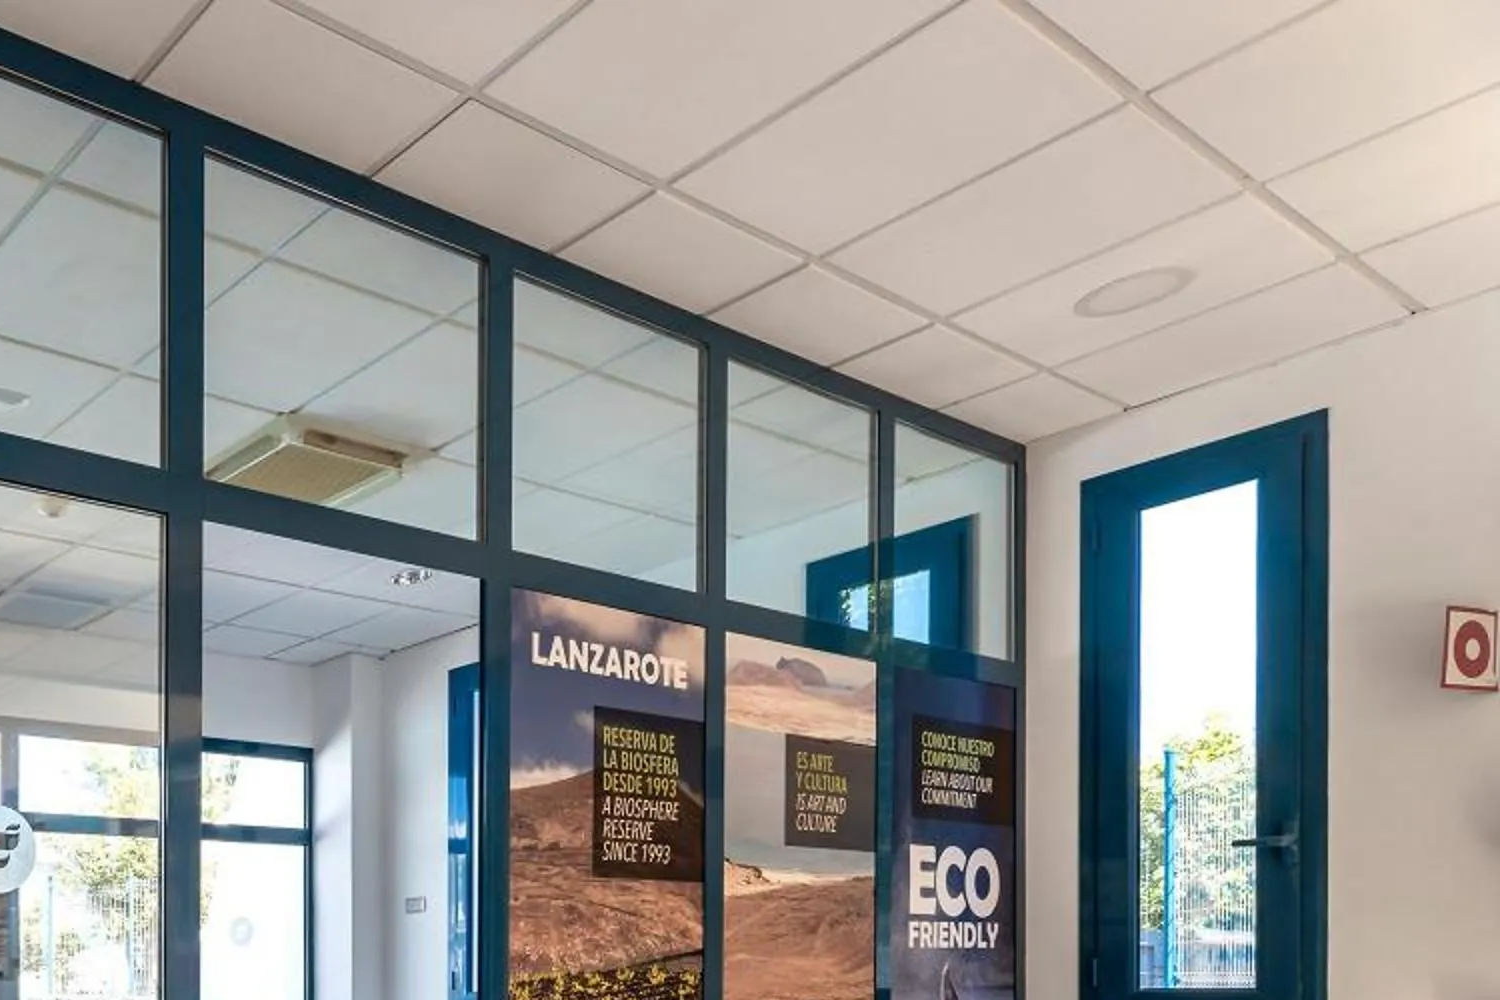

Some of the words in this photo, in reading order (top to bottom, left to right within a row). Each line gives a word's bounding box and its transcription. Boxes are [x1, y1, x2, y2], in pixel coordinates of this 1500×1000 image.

[531, 631, 689, 691] LANZAROTE
[603, 725, 657, 751] RESERVA
[659, 733, 677, 755] DE
[603, 748, 617, 769] LA
[621, 751, 680, 777] BIOSFERA
[796, 751, 808, 769] ES
[809, 753, 834, 773] ARTE
[603, 771, 643, 795] DESDE
[646, 777, 677, 798] 1993
[796, 770, 803, 789] Y
[804, 771, 848, 795] CULTURA
[602, 795, 612, 815] A
[613, 798, 681, 821] BIOSPHERE
[602, 818, 656, 841] RESERVE
[602, 841, 639, 863] SINCE
[642, 844, 672, 865] 1993
[909, 843, 1000, 918] ECO
[908, 920, 999, 949] FRIENDLY
